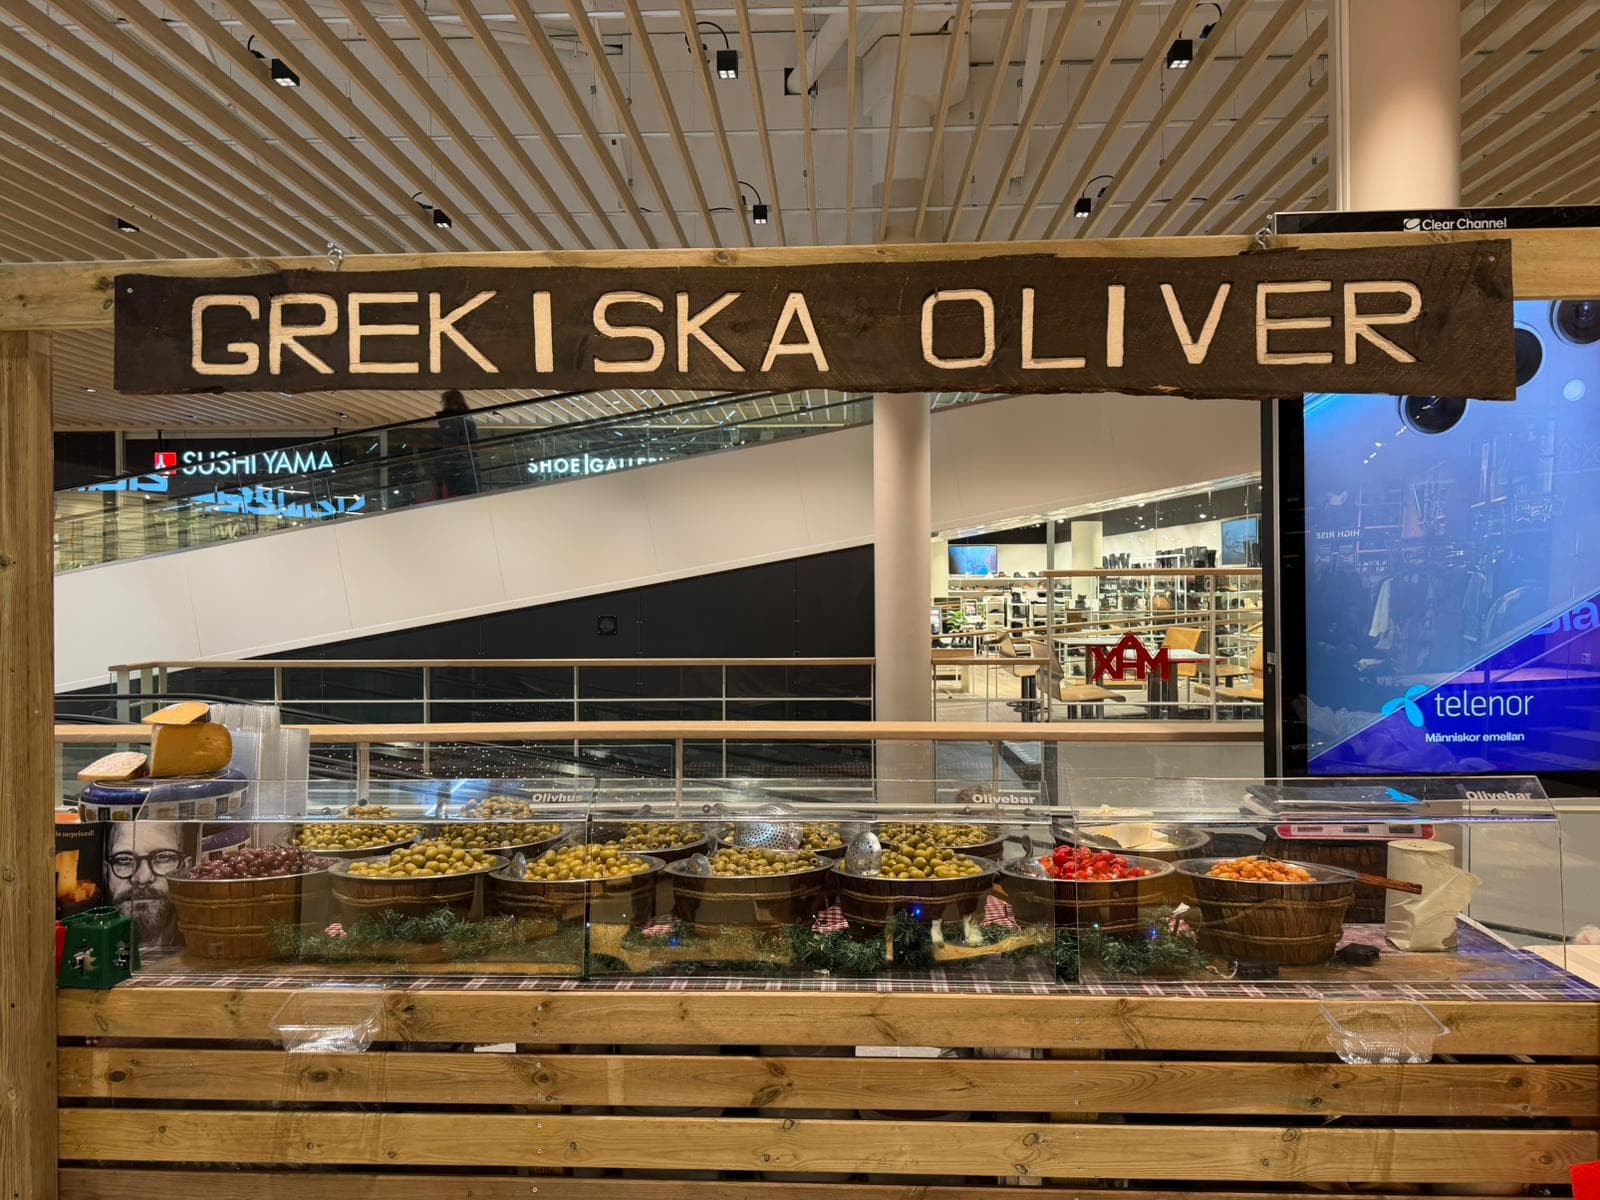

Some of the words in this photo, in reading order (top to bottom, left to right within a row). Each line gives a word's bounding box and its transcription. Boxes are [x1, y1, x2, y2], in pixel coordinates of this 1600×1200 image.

[1422, 219, 1455, 230] Clear
[1456, 217, 1507, 229] Channel
[190, 290, 832, 377] GREKISKA
[920, 279, 1423, 370] OLIVER
[262, 450, 334, 475] YAMA
[1434, 690, 1534, 717] telenor
[1425, 732, 1480, 743] Människor
[1482, 732, 1525, 742] emellan
[972, 793, 1035, 804] Olivebar
[1465, 790, 1532, 800] Olivebar
